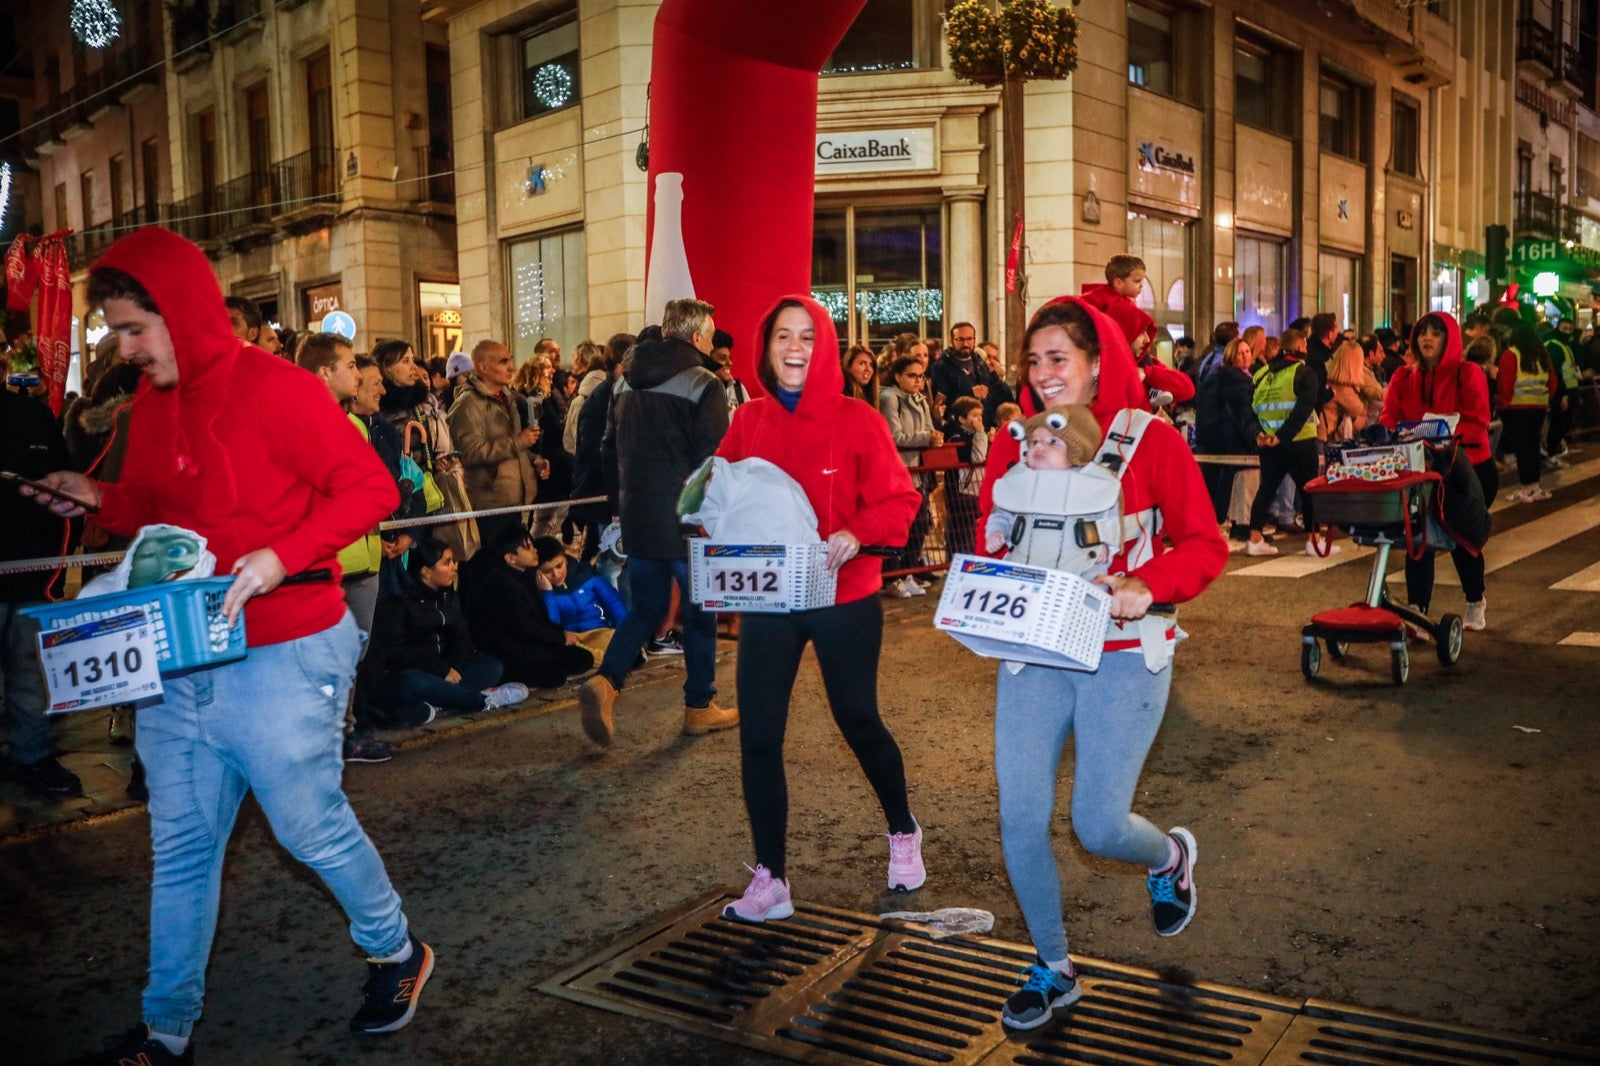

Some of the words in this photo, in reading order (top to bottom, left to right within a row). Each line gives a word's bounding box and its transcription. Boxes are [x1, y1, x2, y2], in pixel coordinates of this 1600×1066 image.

[816, 138, 911, 160] CaixaBank
[1517, 242, 1556, 261] 16H
[313, 296, 340, 314] ÓPTICA
[433, 327, 463, 357] 17
[715, 571, 778, 592] 1312
[963, 588, 1028, 619] 1126
[64, 646, 142, 688] 1310
